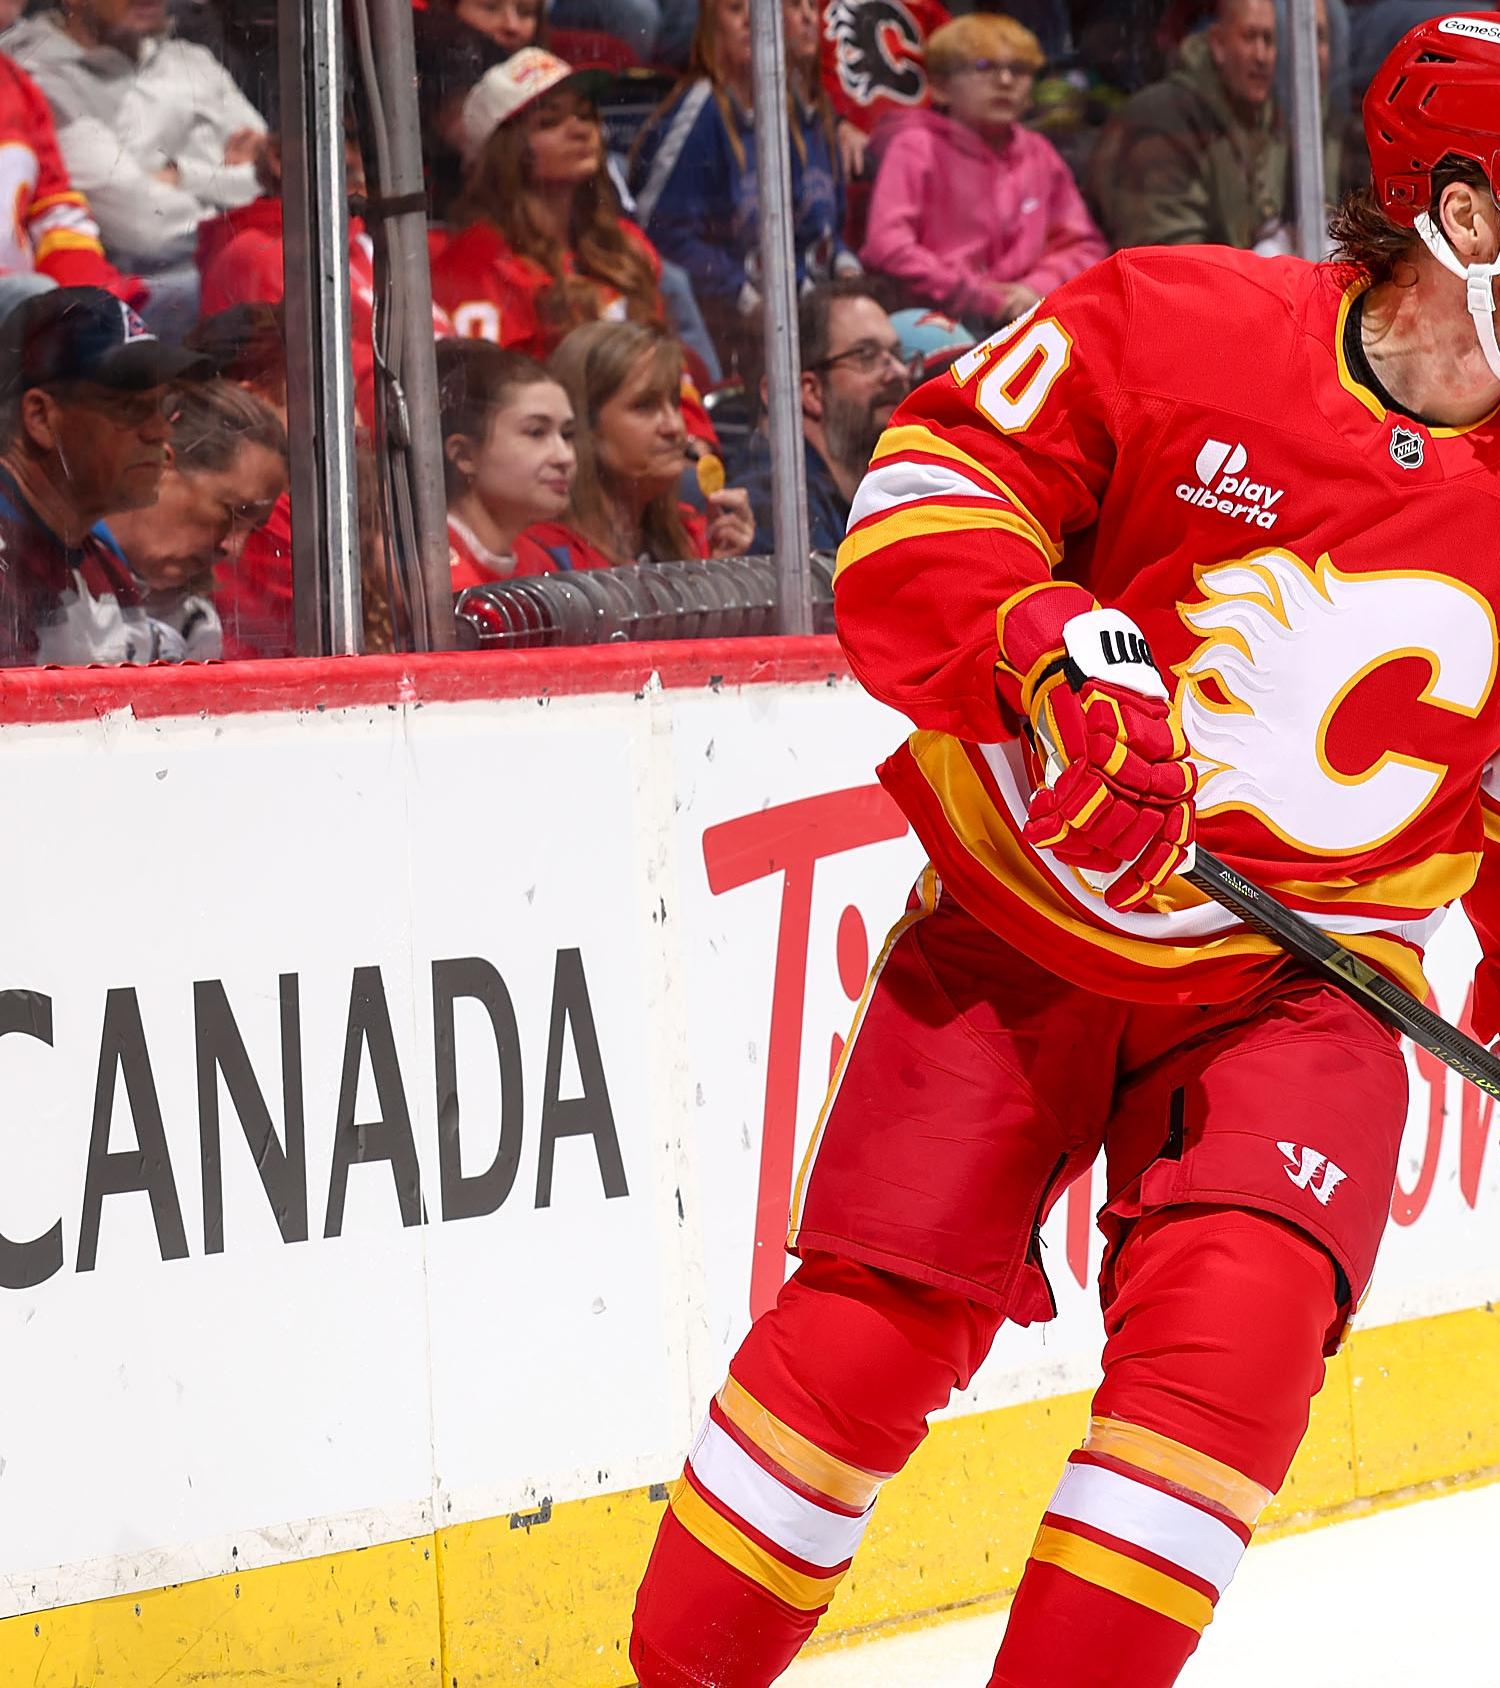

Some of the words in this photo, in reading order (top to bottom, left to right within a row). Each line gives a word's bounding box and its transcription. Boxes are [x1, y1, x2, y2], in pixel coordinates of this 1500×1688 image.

[1397, 440, 1417, 457] NHL
[1175, 484, 1278, 530] alberta
[1214, 475, 1284, 510] play
[1427, 1046, 1477, 1079] ALPHA
